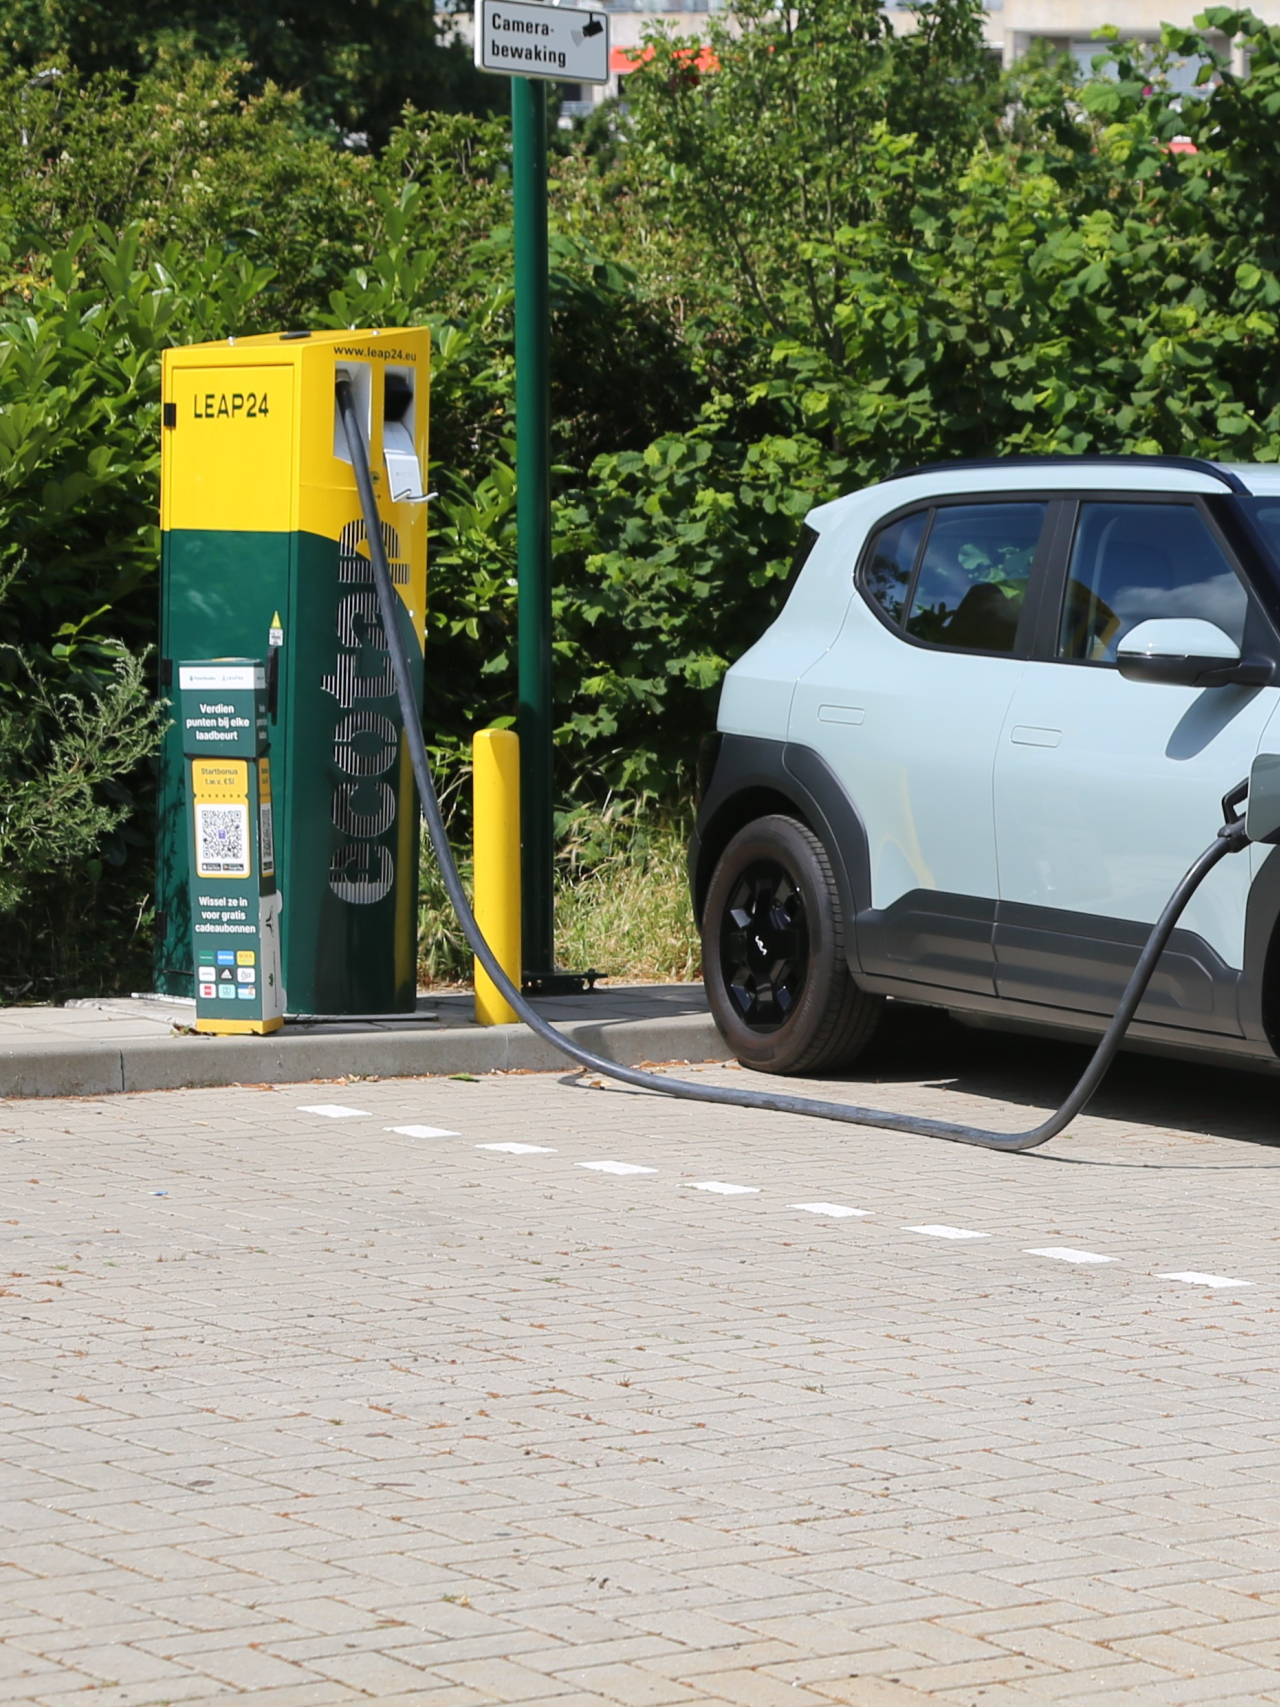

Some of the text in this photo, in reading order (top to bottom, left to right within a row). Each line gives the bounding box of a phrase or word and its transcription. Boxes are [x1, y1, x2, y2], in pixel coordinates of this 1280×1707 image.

[492, 12, 554, 36] Camera-
[491, 39, 566, 68] bewaking
[333, 345, 417, 362] www.leap24.eu
[193, 392, 270, 419] LEAP24
[199, 703, 235, 714] Verdien
[320, 518, 410, 904] ecotap
[186, 716, 250, 729] punten bij elke
[195, 730, 238, 741] laadbeurt
[201, 767, 239, 775] Startbonus
[199, 896, 248, 907] Wissel ze in
[201, 910, 246, 922] voor gratis
[195, 923, 256, 934] cadeaubonnen
